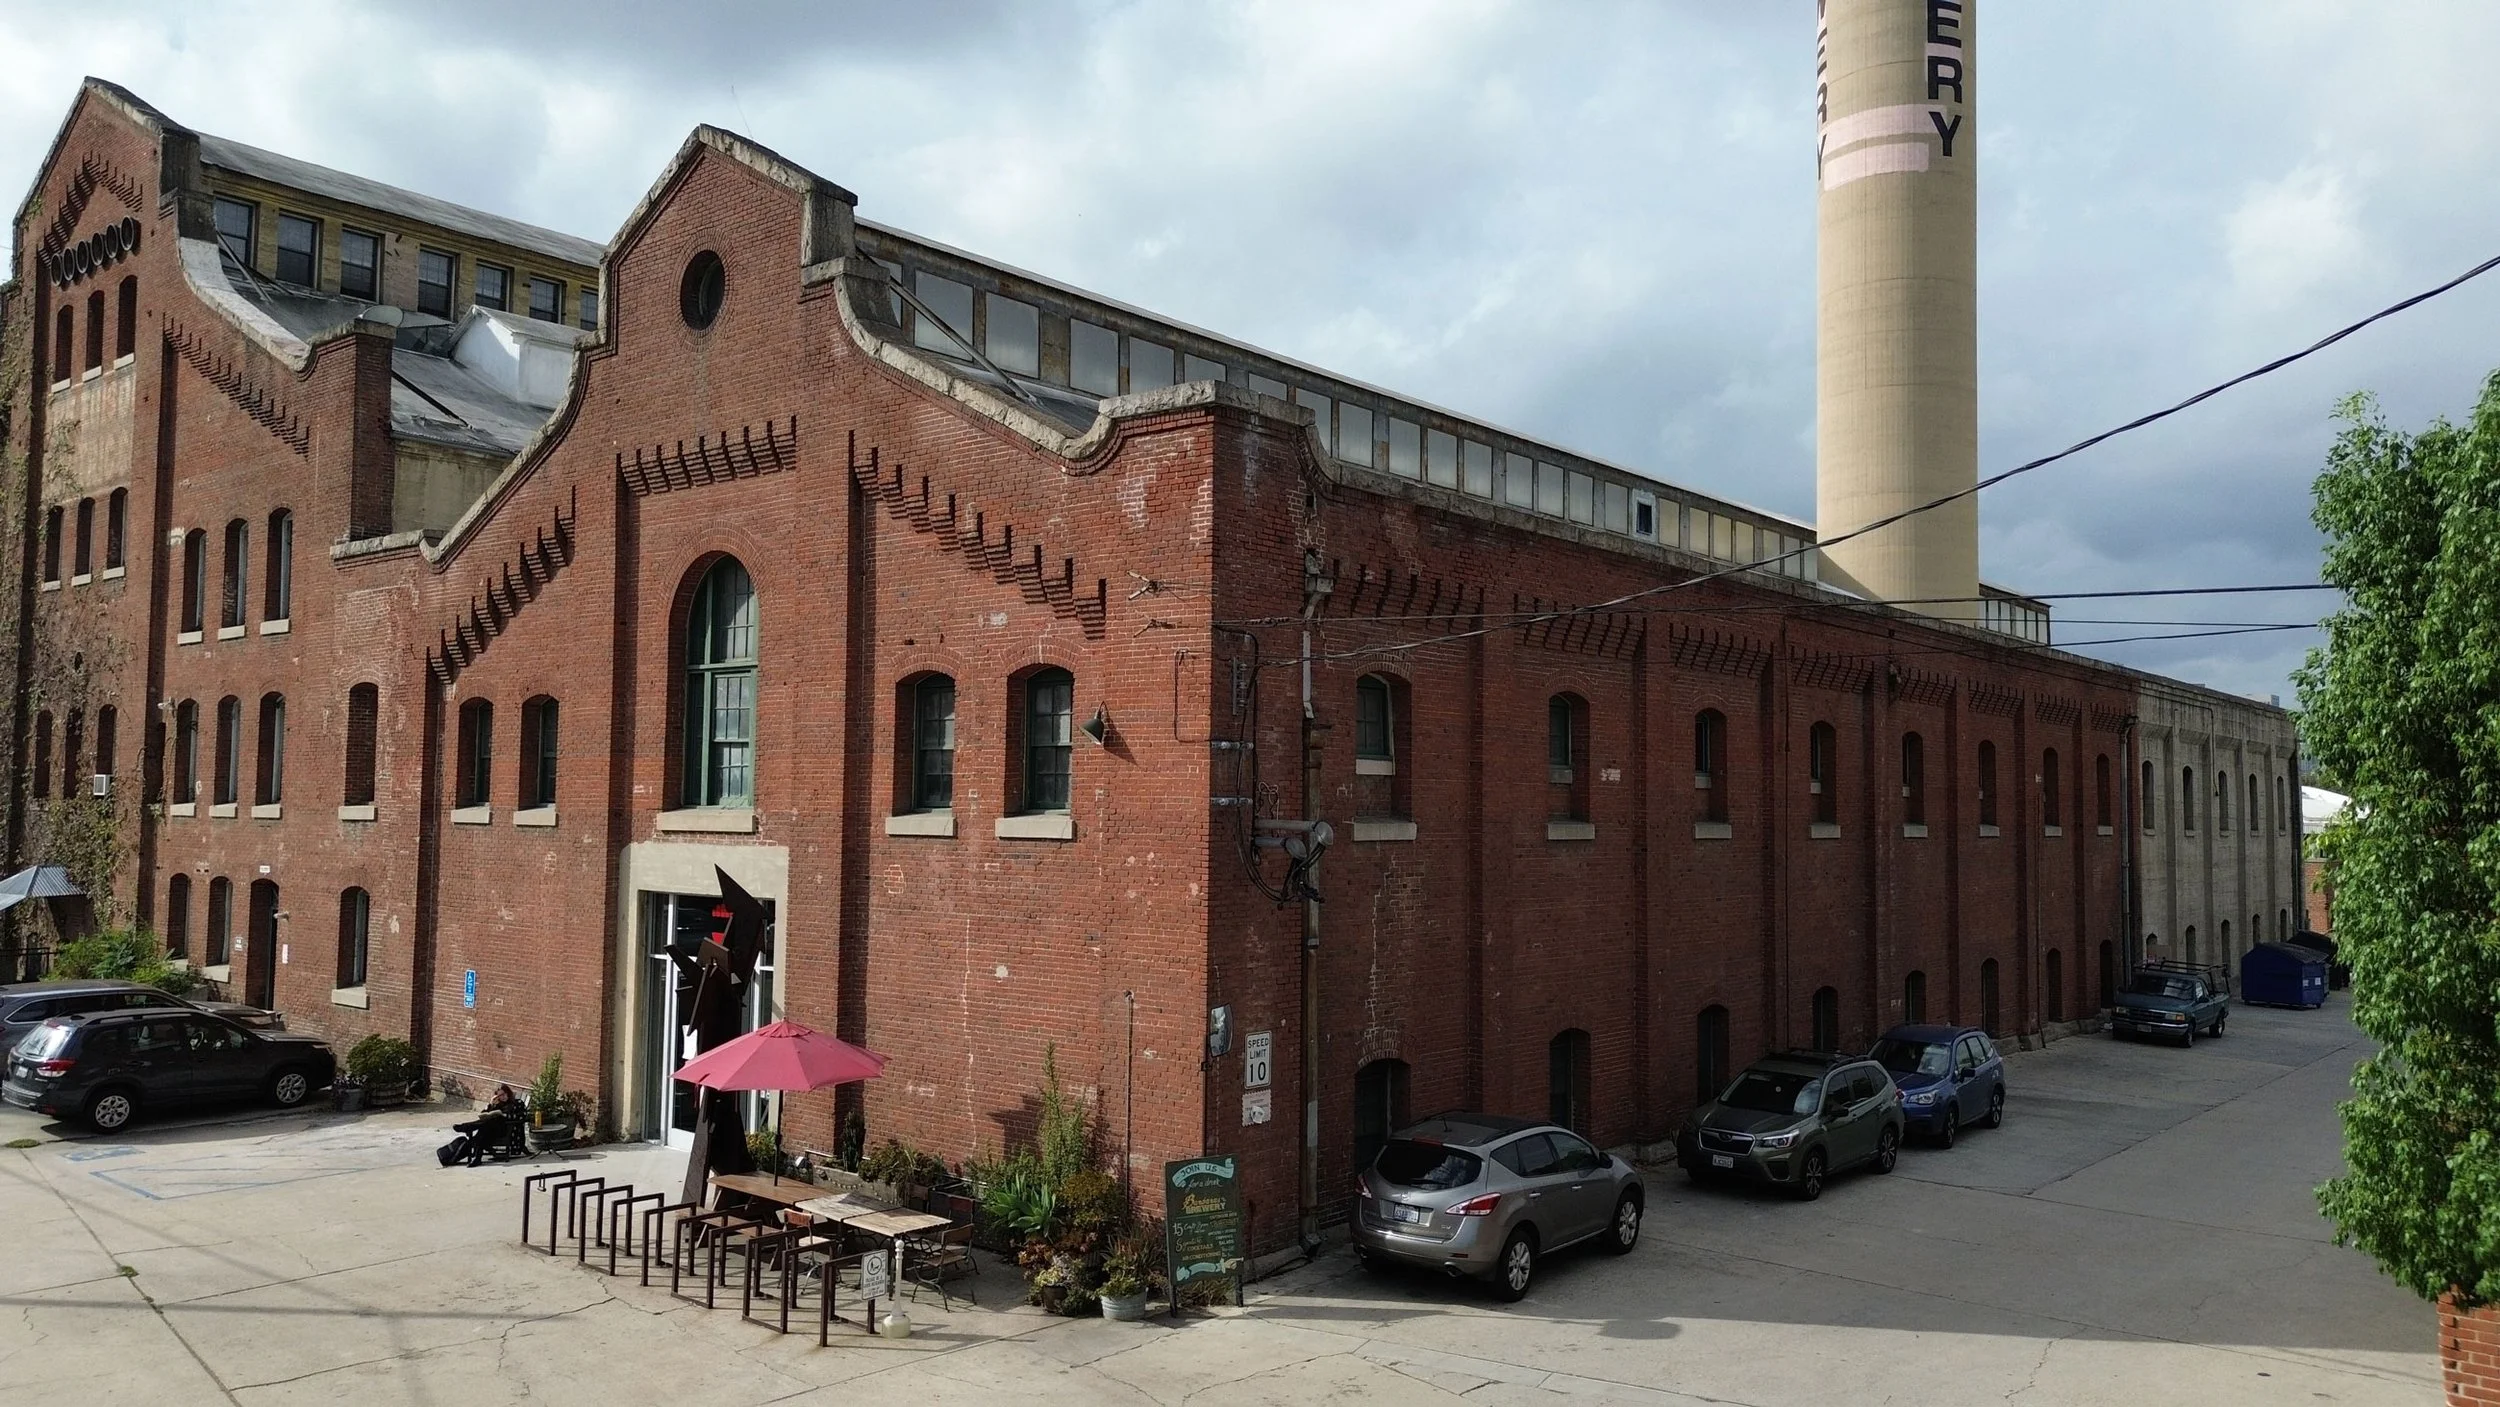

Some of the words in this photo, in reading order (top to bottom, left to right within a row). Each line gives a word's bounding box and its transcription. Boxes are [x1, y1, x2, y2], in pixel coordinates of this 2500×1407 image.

[1927, 0, 1963, 158] ERY
[1248, 1038, 1269, 1048] SPEED
[1249, 1049, 1266, 1059] LIMIT
[1250, 1061, 1266, 1082] 10
[1180, 1165, 1200, 1176] JOIN
[1205, 1164, 1217, 1172] US
[1172, 1222, 1184, 1237] 15
